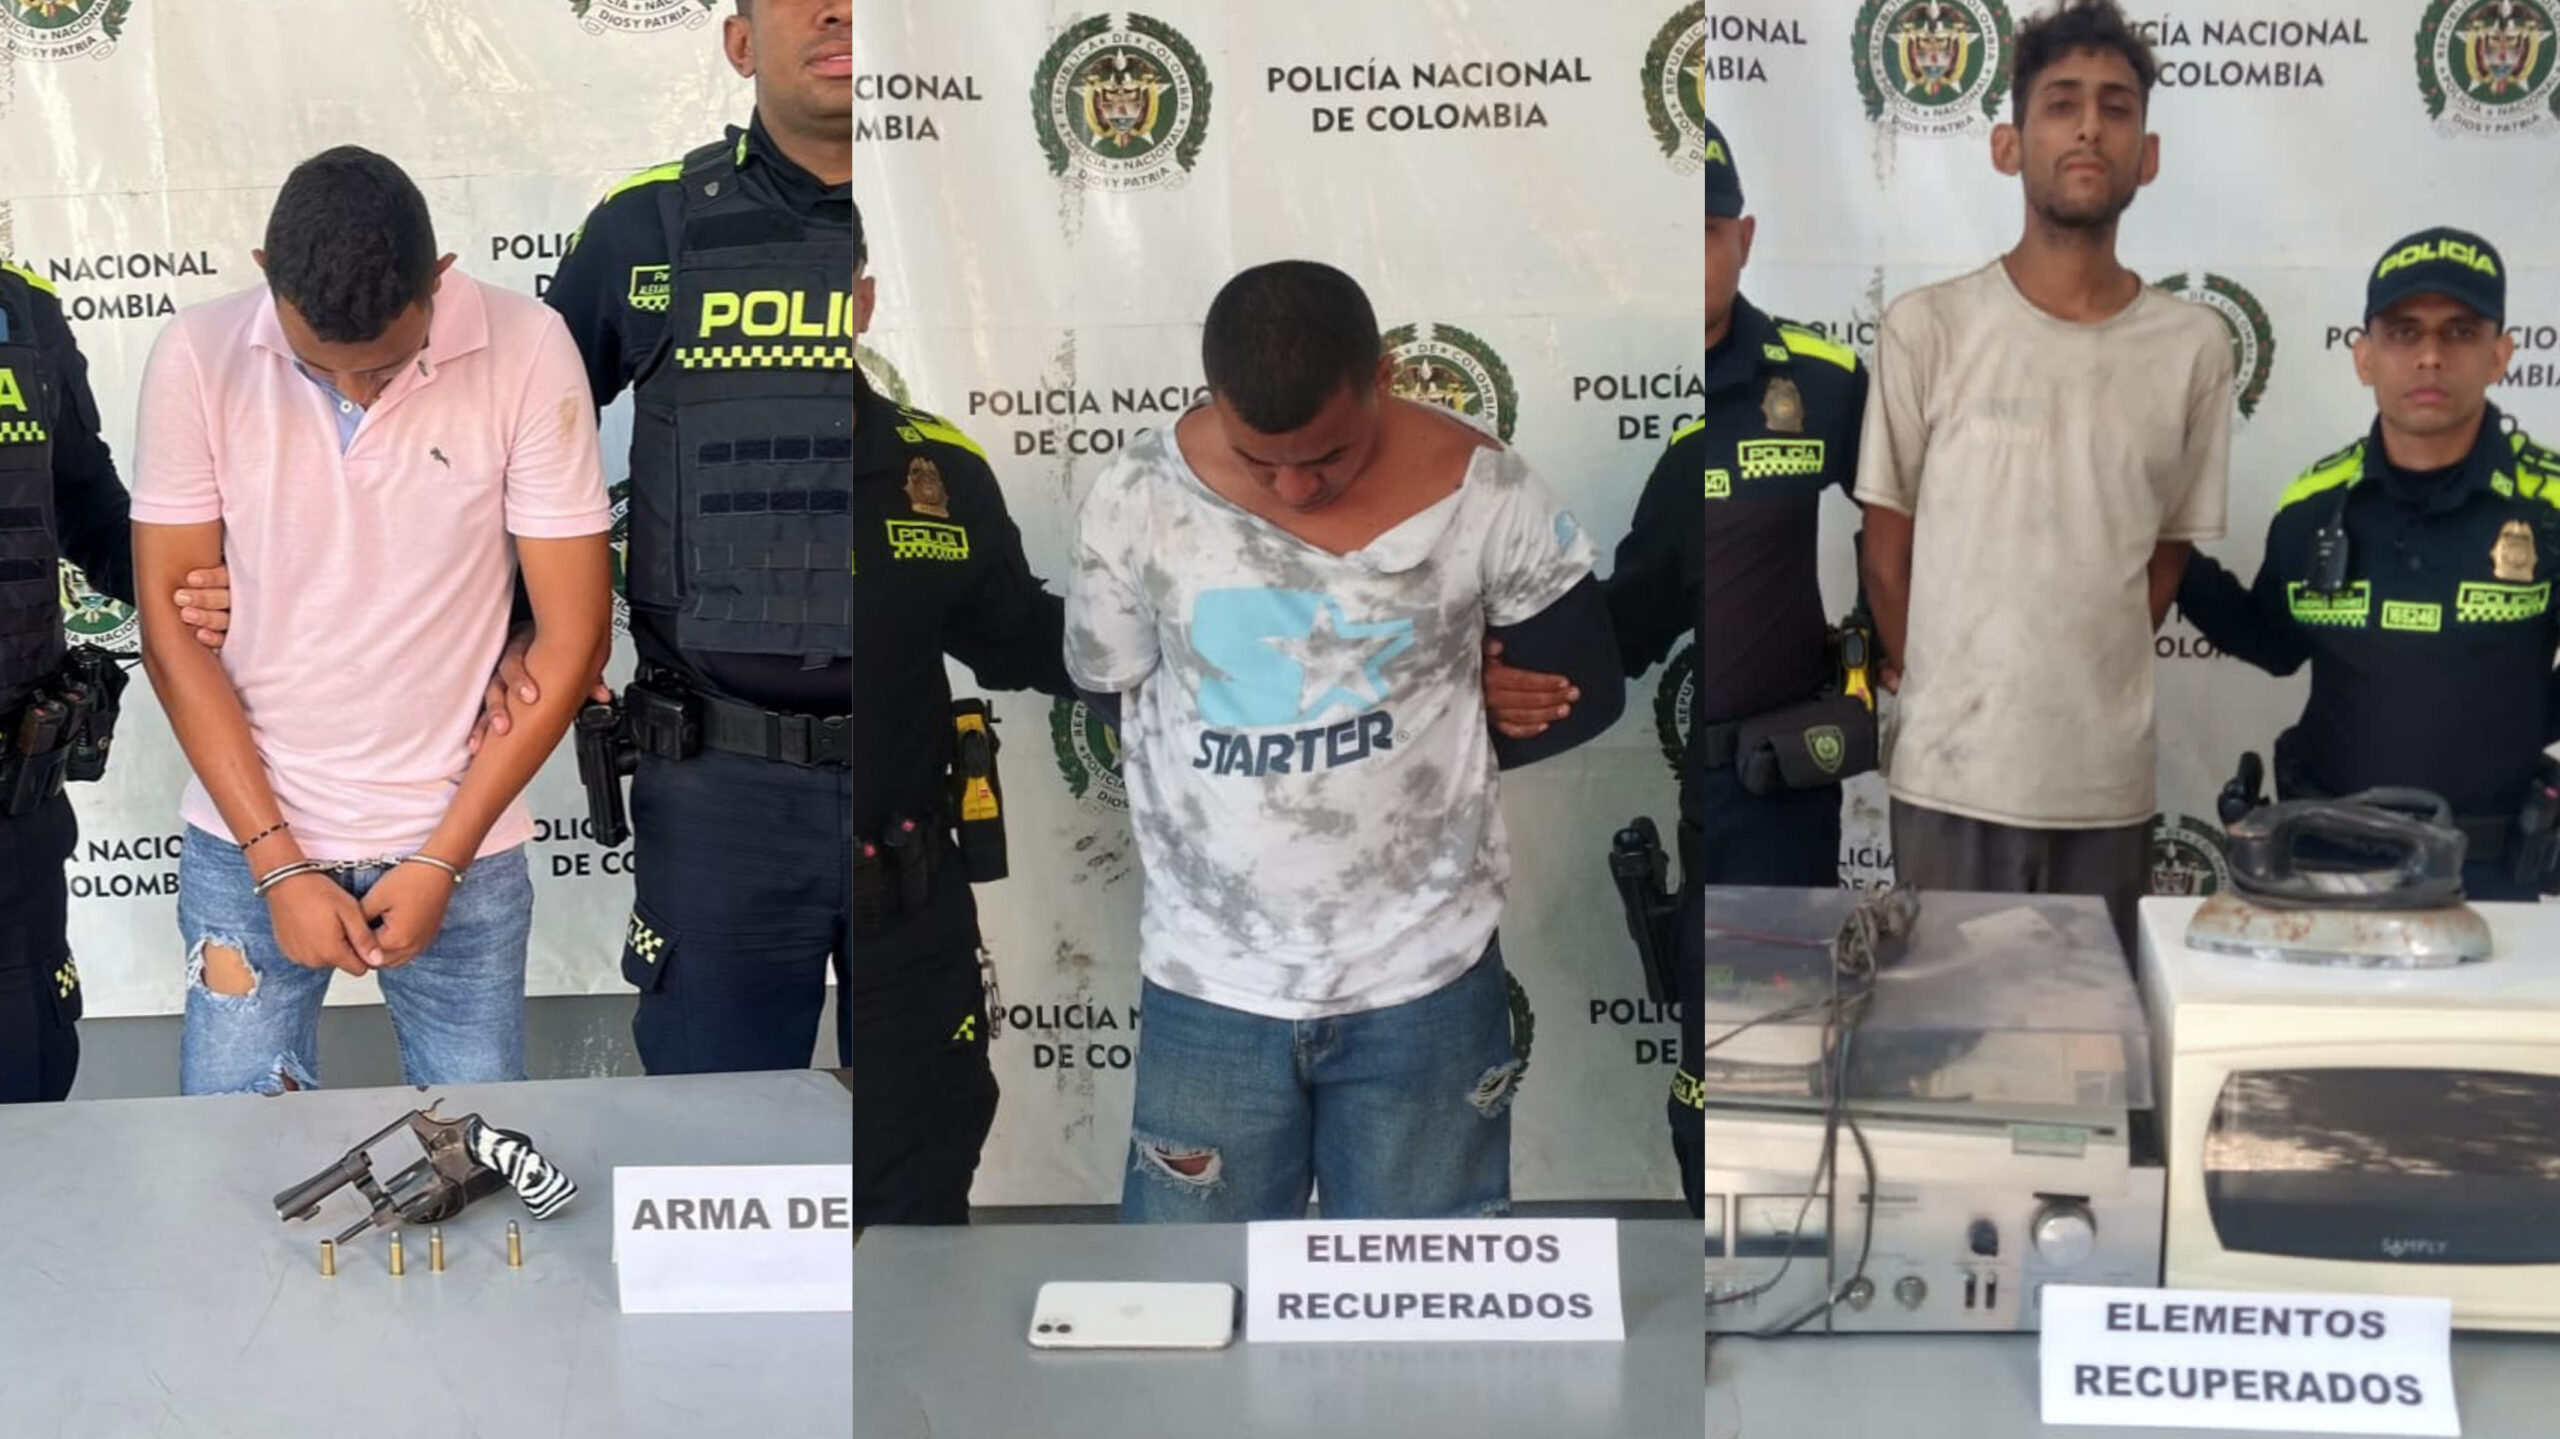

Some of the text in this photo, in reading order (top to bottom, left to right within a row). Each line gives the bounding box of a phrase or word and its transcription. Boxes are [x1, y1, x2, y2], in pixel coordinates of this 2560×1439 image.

[2202, 18, 2368, 47] NACIONAL
[1267, 57, 1591, 93] POLICÍA NACIONAL
[2157, 60, 2325, 87] COLOMBIA
[1312, 103, 1549, 133] DE COLOMBIA
[49, 251, 218, 282] NACIONAL
[1618, 415, 1661, 440] DE
[1014, 430, 1057, 456] DE
[1192, 710, 1394, 778] STARTER
[552, 853, 591, 876] DE
[1033, 1044, 1075, 1069] DE
[1635, 1039, 1679, 1065] DE
[632, 1197, 850, 1231] ARMA DE
[1306, 1233, 1560, 1264] ELEMENTOS
[1277, 1292, 1594, 1320] RECUPERADOS
[2105, 1302, 2387, 1340] ELEMENTOS
[2074, 1363, 2424, 1407] RECUPERADOS
